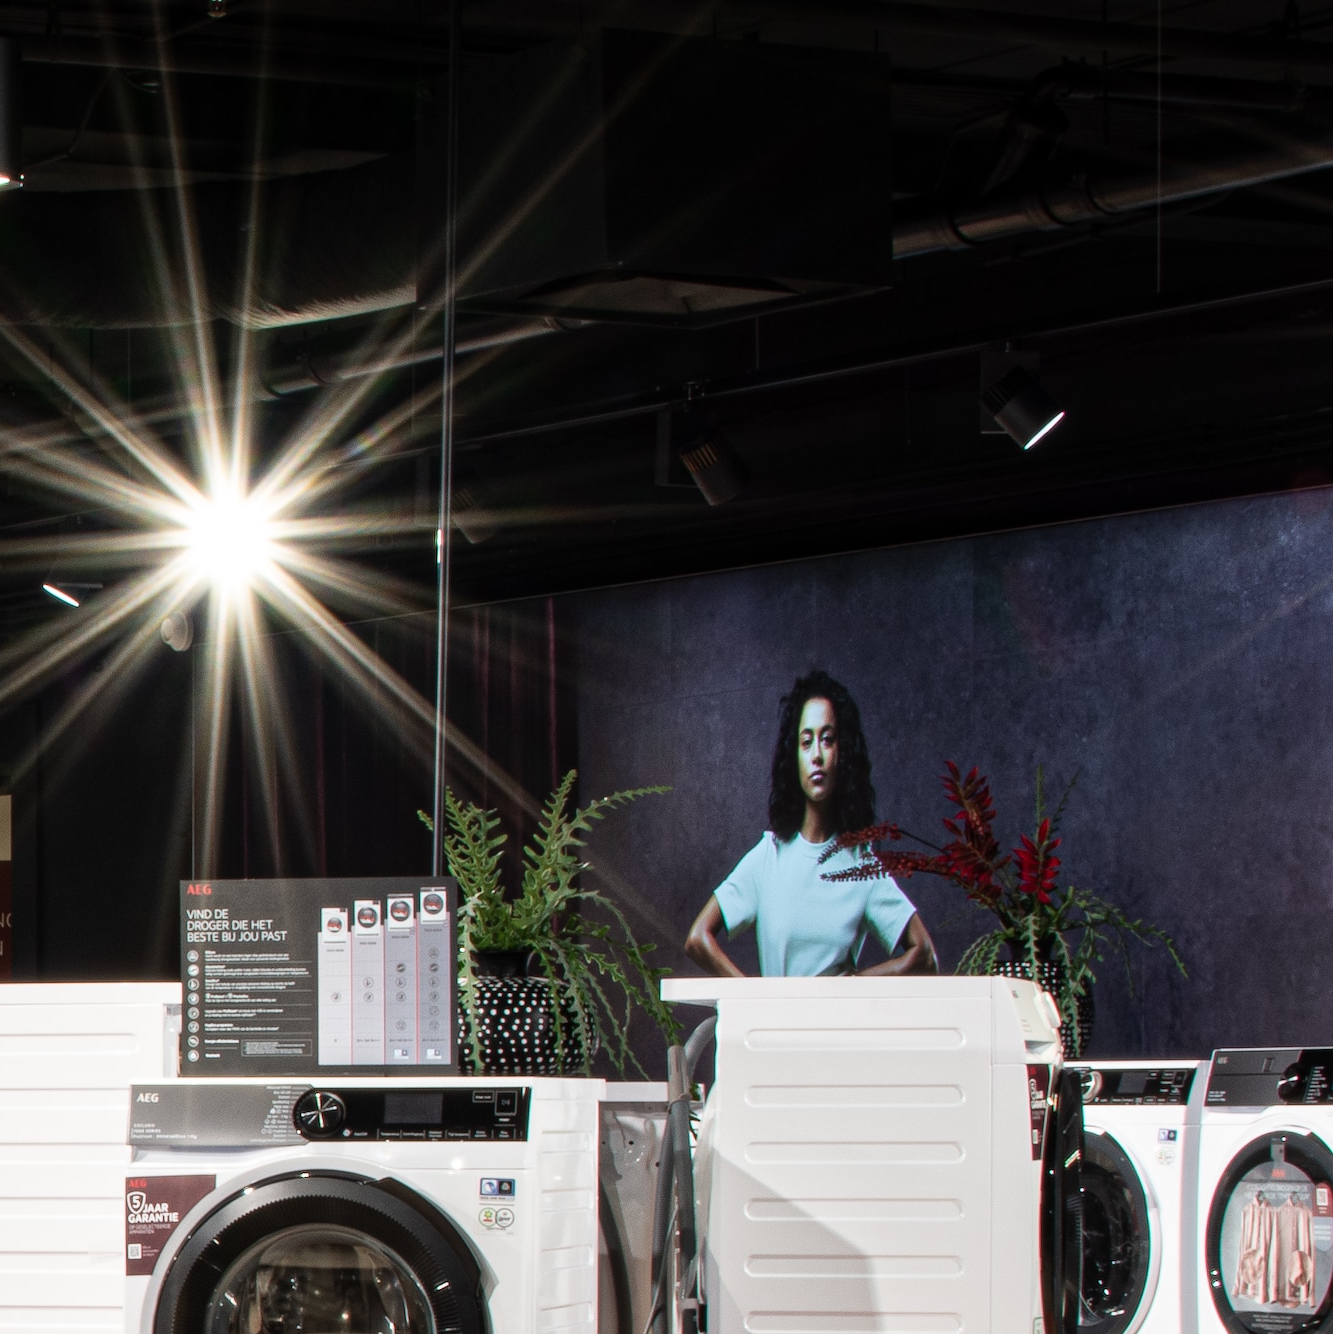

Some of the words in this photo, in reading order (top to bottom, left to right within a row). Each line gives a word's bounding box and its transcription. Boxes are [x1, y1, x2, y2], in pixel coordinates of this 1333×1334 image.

[186, 884, 212, 896] AEG
[186, 909, 212, 920] VIND
[214, 908, 229, 919] DE
[186, 920, 229, 931] DROGER
[232, 919, 248, 930] DIE
[251, 919, 273, 930] HET
[186, 931, 219, 942] BESTE
[222, 931, 235, 942] BIJ
[238, 931, 259, 942] JOU
[261, 930, 288, 941] PAST
[136, 1092, 159, 1103] AEG
[129, 1179, 147, 1188] AEG
[132, 1195, 141, 1209] 5
[143, 1203, 169, 1213] JAAR
[128, 1212, 179, 1223] GARANTIE
